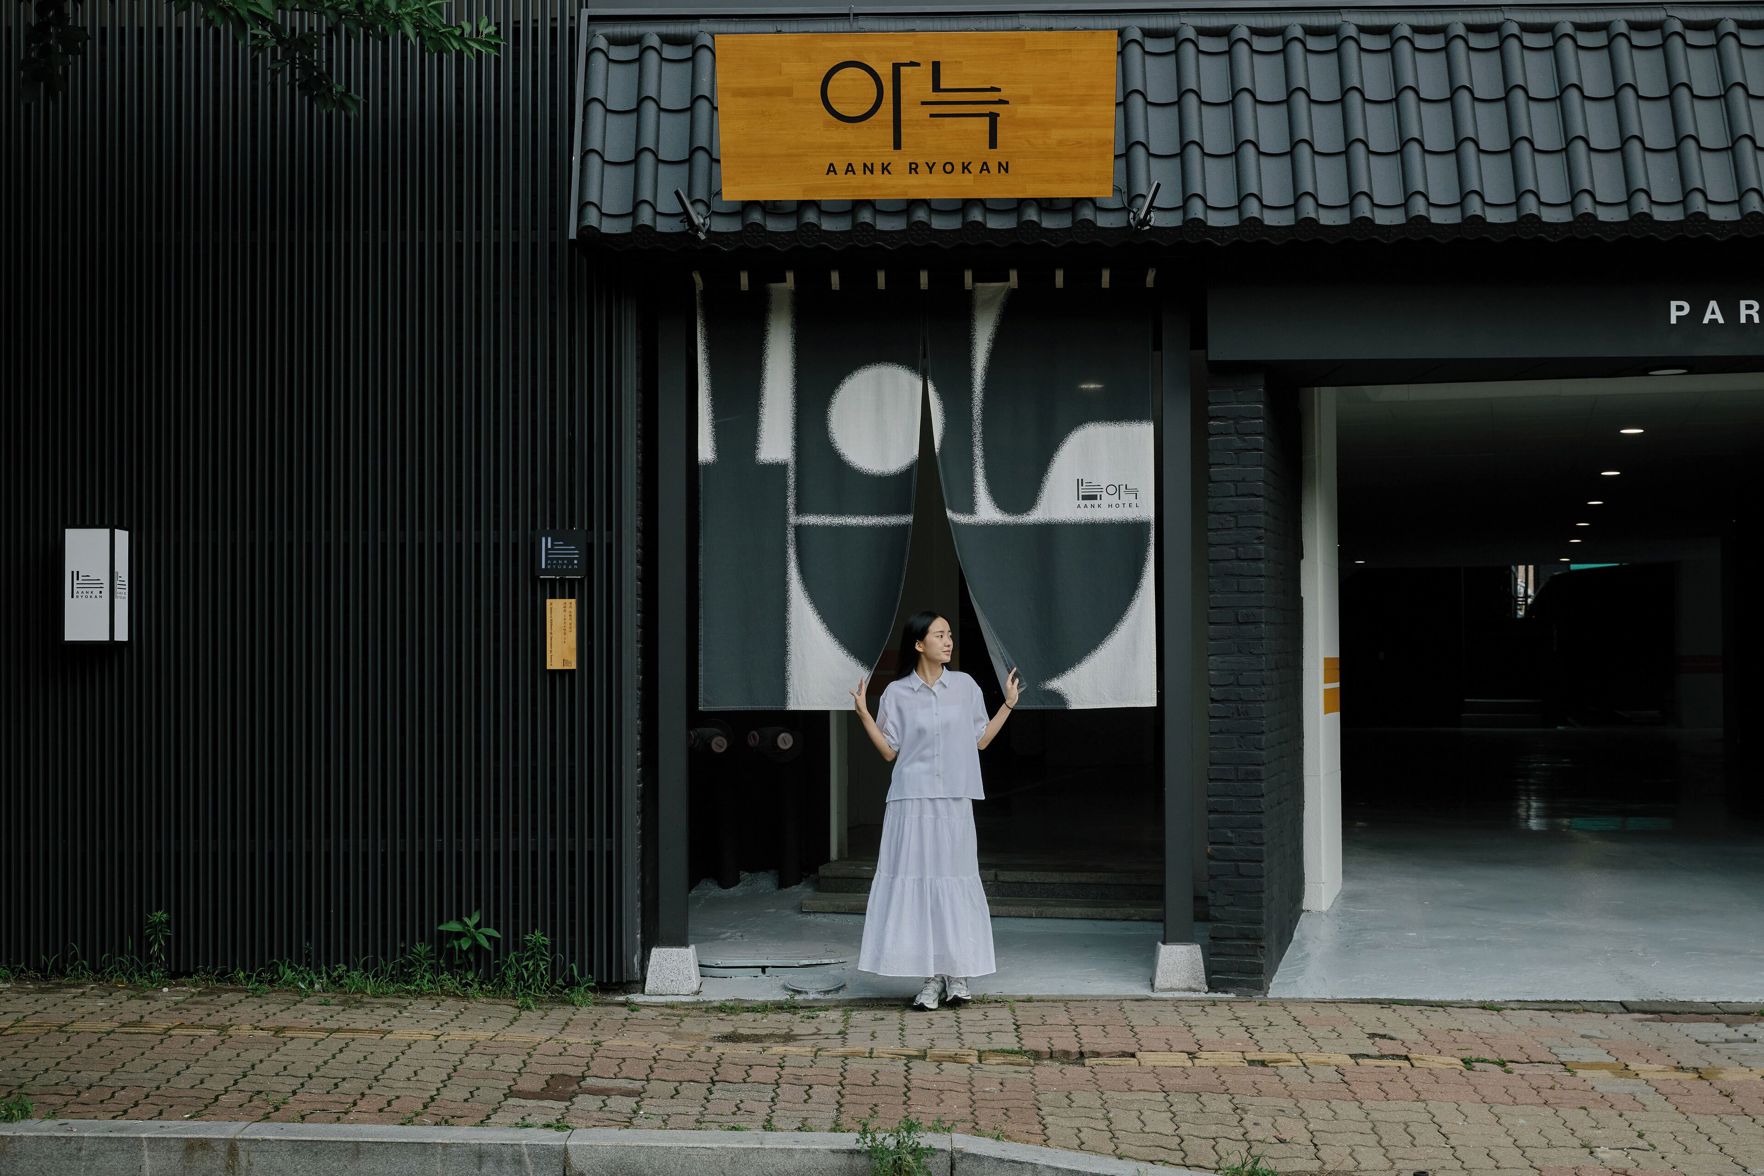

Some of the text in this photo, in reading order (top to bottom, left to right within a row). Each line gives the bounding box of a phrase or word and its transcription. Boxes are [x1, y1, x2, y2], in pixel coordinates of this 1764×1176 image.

[820, 60, 1010, 151] 아늑
[825, 160, 1009, 176] AANK RYOKAN
[1670, 299, 1761, 325] PAR
